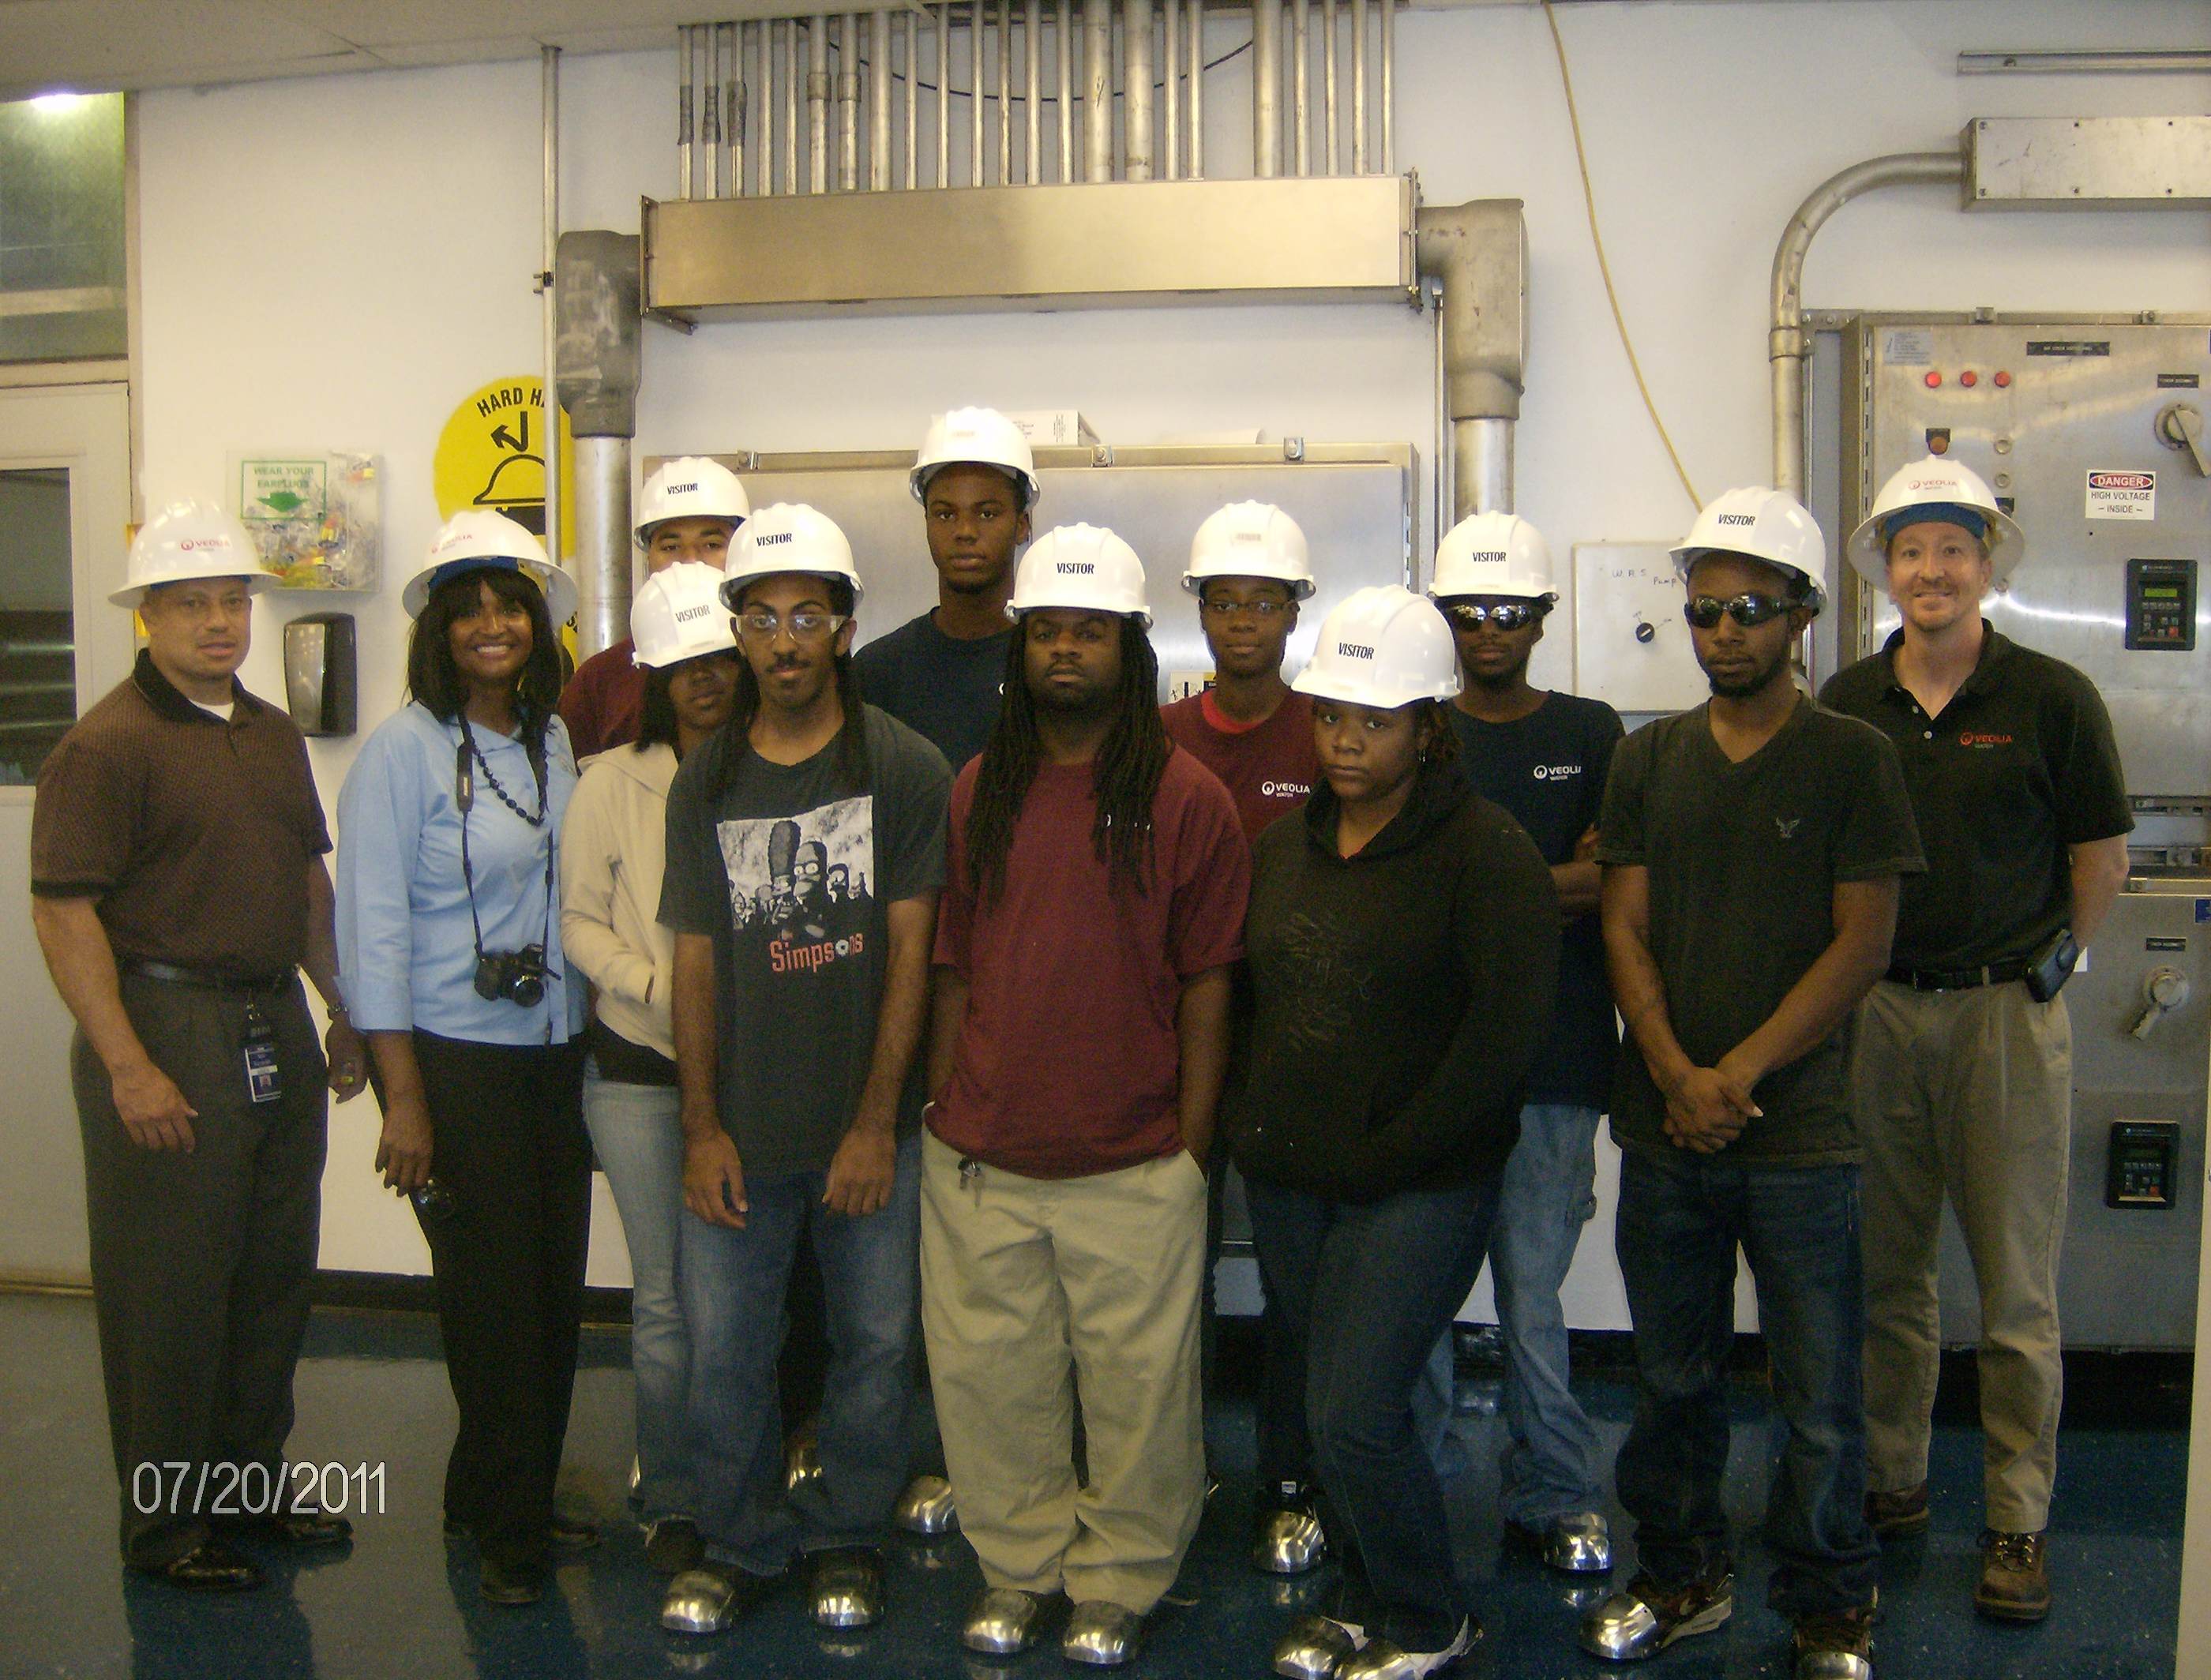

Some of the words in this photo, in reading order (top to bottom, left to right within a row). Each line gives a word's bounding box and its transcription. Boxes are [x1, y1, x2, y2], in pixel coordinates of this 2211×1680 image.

[476, 387, 524, 418] HARD
[286, 467, 314, 475] YOUR
[2097, 476, 2144, 487] DANGER
[666, 482, 698, 495] VISITOR
[2091, 491, 2111, 500] HIGH
[2113, 492, 2150, 501] VOLTAGE
[2107, 504, 2133, 513] INSIDE
[1717, 513, 1757, 526] VISITOR
[756, 533, 793, 547] VISITOR
[1472, 551, 1507, 563] VISITOR
[1057, 562, 1094, 575] VISITOR
[675, 605, 711, 623] VISITOR
[1338, 642, 1375, 660] VISITOR
[1275, 782, 1311, 794] VEOLIA
[769, 932, 865, 973] Simpsons
